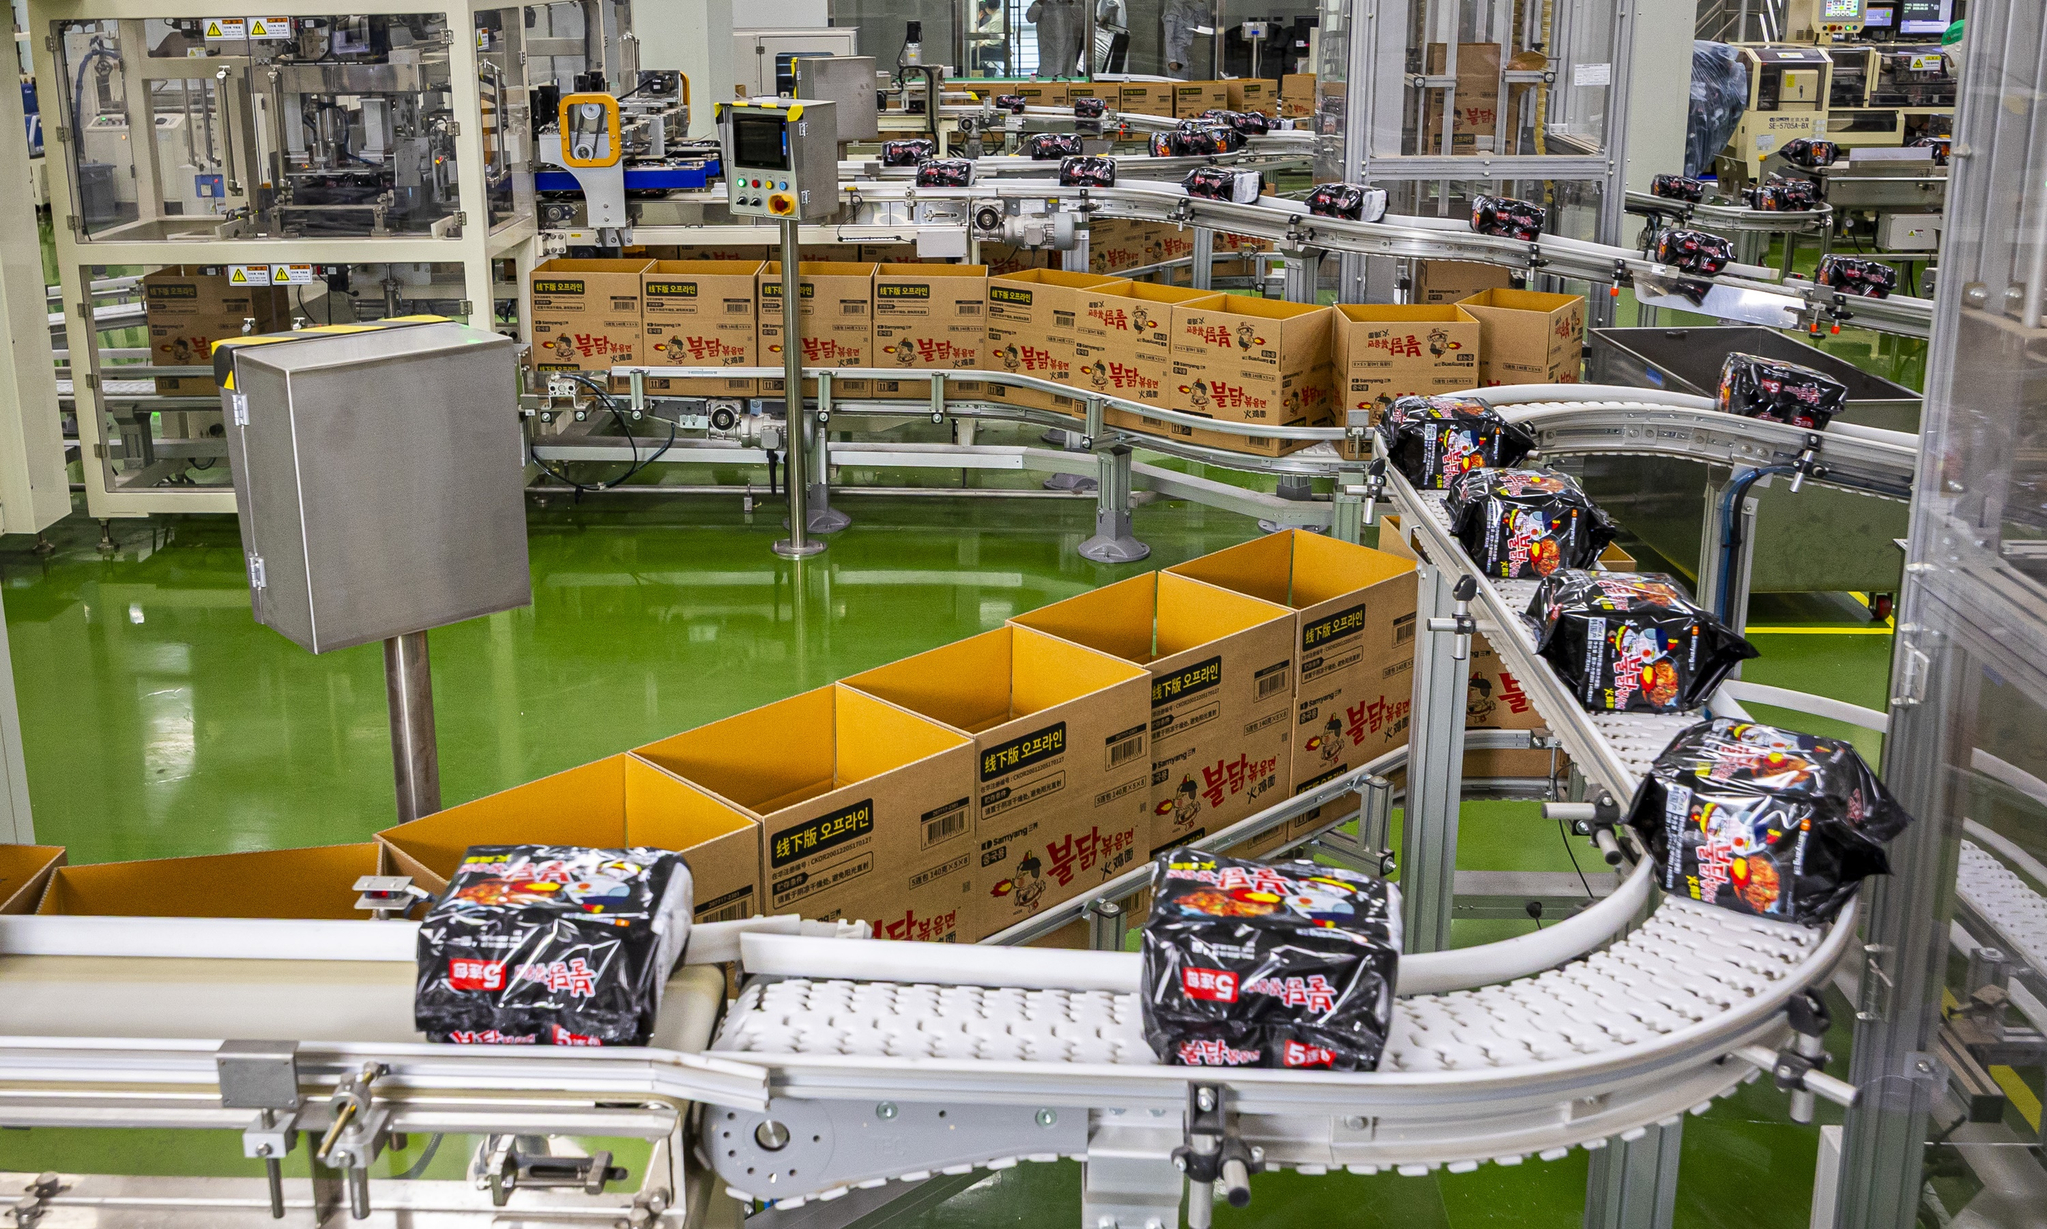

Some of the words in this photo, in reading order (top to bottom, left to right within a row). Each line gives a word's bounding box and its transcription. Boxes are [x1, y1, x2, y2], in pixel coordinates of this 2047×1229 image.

[536, 283, 556, 292] 线下版
[557, 283, 582, 292] 오프라인
[649, 285, 668, 293] 线下版
[670, 285, 696, 294] 오프라인
[880, 286, 900, 296] 线下版
[902, 287, 928, 296] 오프라인
[992, 289, 1009, 300] 线下版
[1009, 291, 1032, 303] 오프라인
[1088, 309, 1128, 331] 불닭볶음면
[574, 334, 632, 358] 불닭볶음면
[686, 336, 744, 360] 불닭볶음면
[802, 337, 860, 361] 불닭볶음면
[1186, 325, 1232, 348] 불닭볶음면
[1368, 335, 1422, 357] 불닭볶음면
[917, 339, 975, 363] 불닭볶음면
[1020, 346, 1069, 371] 불닭볶음면
[1109, 362, 1159, 389] 불닭볶음면
[1210, 381, 1267, 408] 불닭볶음면
[1507, 534, 1531, 578] 불닭볶음면
[1305, 623, 1331, 644] 线下版
[1332, 609, 1363, 633] 오프라인
[1688, 635, 1698, 665] Samyang
[1152, 677, 1182, 701] 线下版
[1183, 662, 1218, 688] 오프라인
[1613, 655, 1643, 710] 불닭볶음면
[1308, 692, 1334, 708] Samyang
[1345, 695, 1410, 746] 불닭볶음면
[985, 746, 1019, 774] 线下版
[1021, 729, 1062, 758] 오프라인
[1157, 752, 1187, 769] Samyang
[1201, 753, 1276, 809] 불닭볶음면
[1247, 774, 1275, 804] 火鸡面
[776, 827, 818, 858] 线下版
[820, 807, 869, 841] 오프라인
[993, 827, 1028, 847] Samyang
[1046, 826, 1134, 887] 불닭볶음면
[1100, 847, 1134, 881] 火鸡面
[1696, 840, 1734, 904] 불닭볶음면
[1187, 972, 1233, 1000] 5连包
[1248, 974, 1338, 1014] 불닭볶음면
